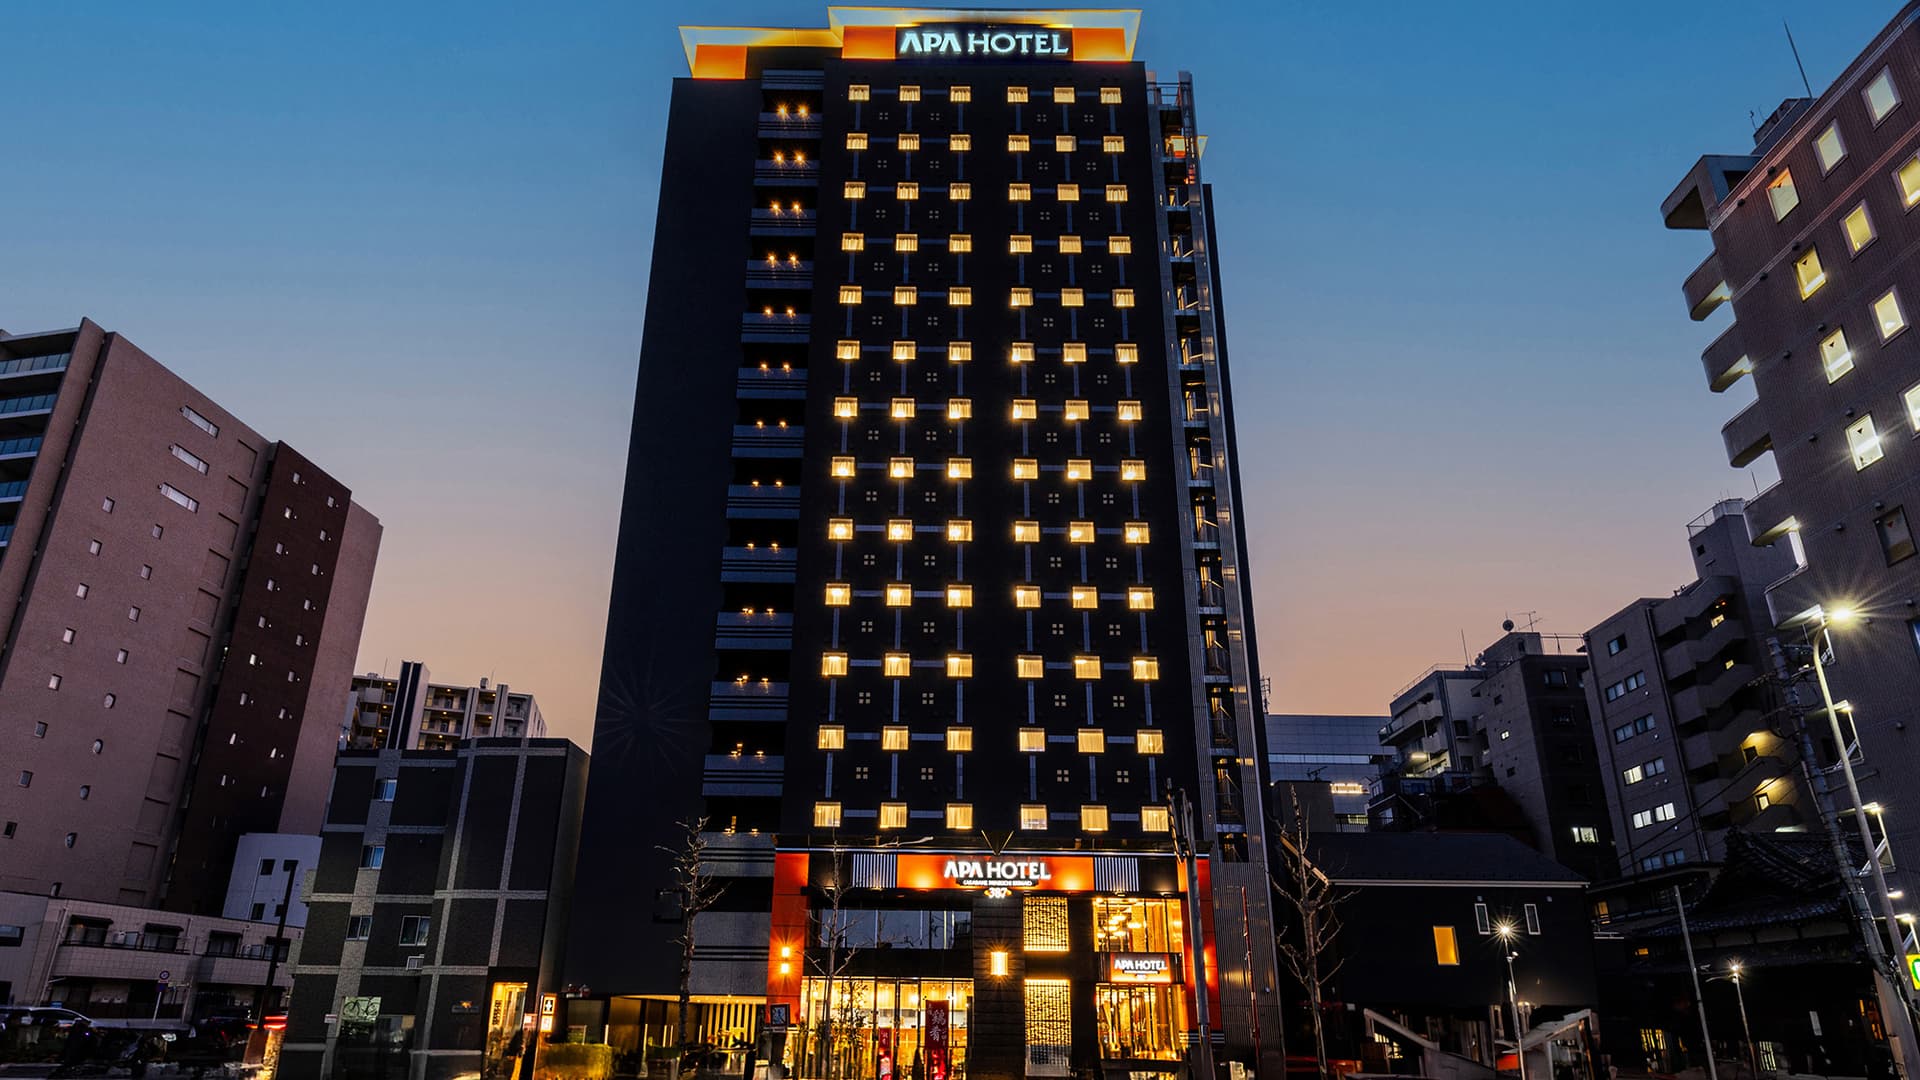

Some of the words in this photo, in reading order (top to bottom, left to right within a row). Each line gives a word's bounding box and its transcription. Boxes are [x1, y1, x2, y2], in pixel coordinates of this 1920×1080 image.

[898, 32, 962, 54] APA
[967, 33, 1069, 55] HOTEL
[944, 860, 984, 878] APA
[986, 861, 1051, 880] HOTEL
[1114, 960, 1134, 970] APA
[1135, 960, 1168, 970] HOTEL
